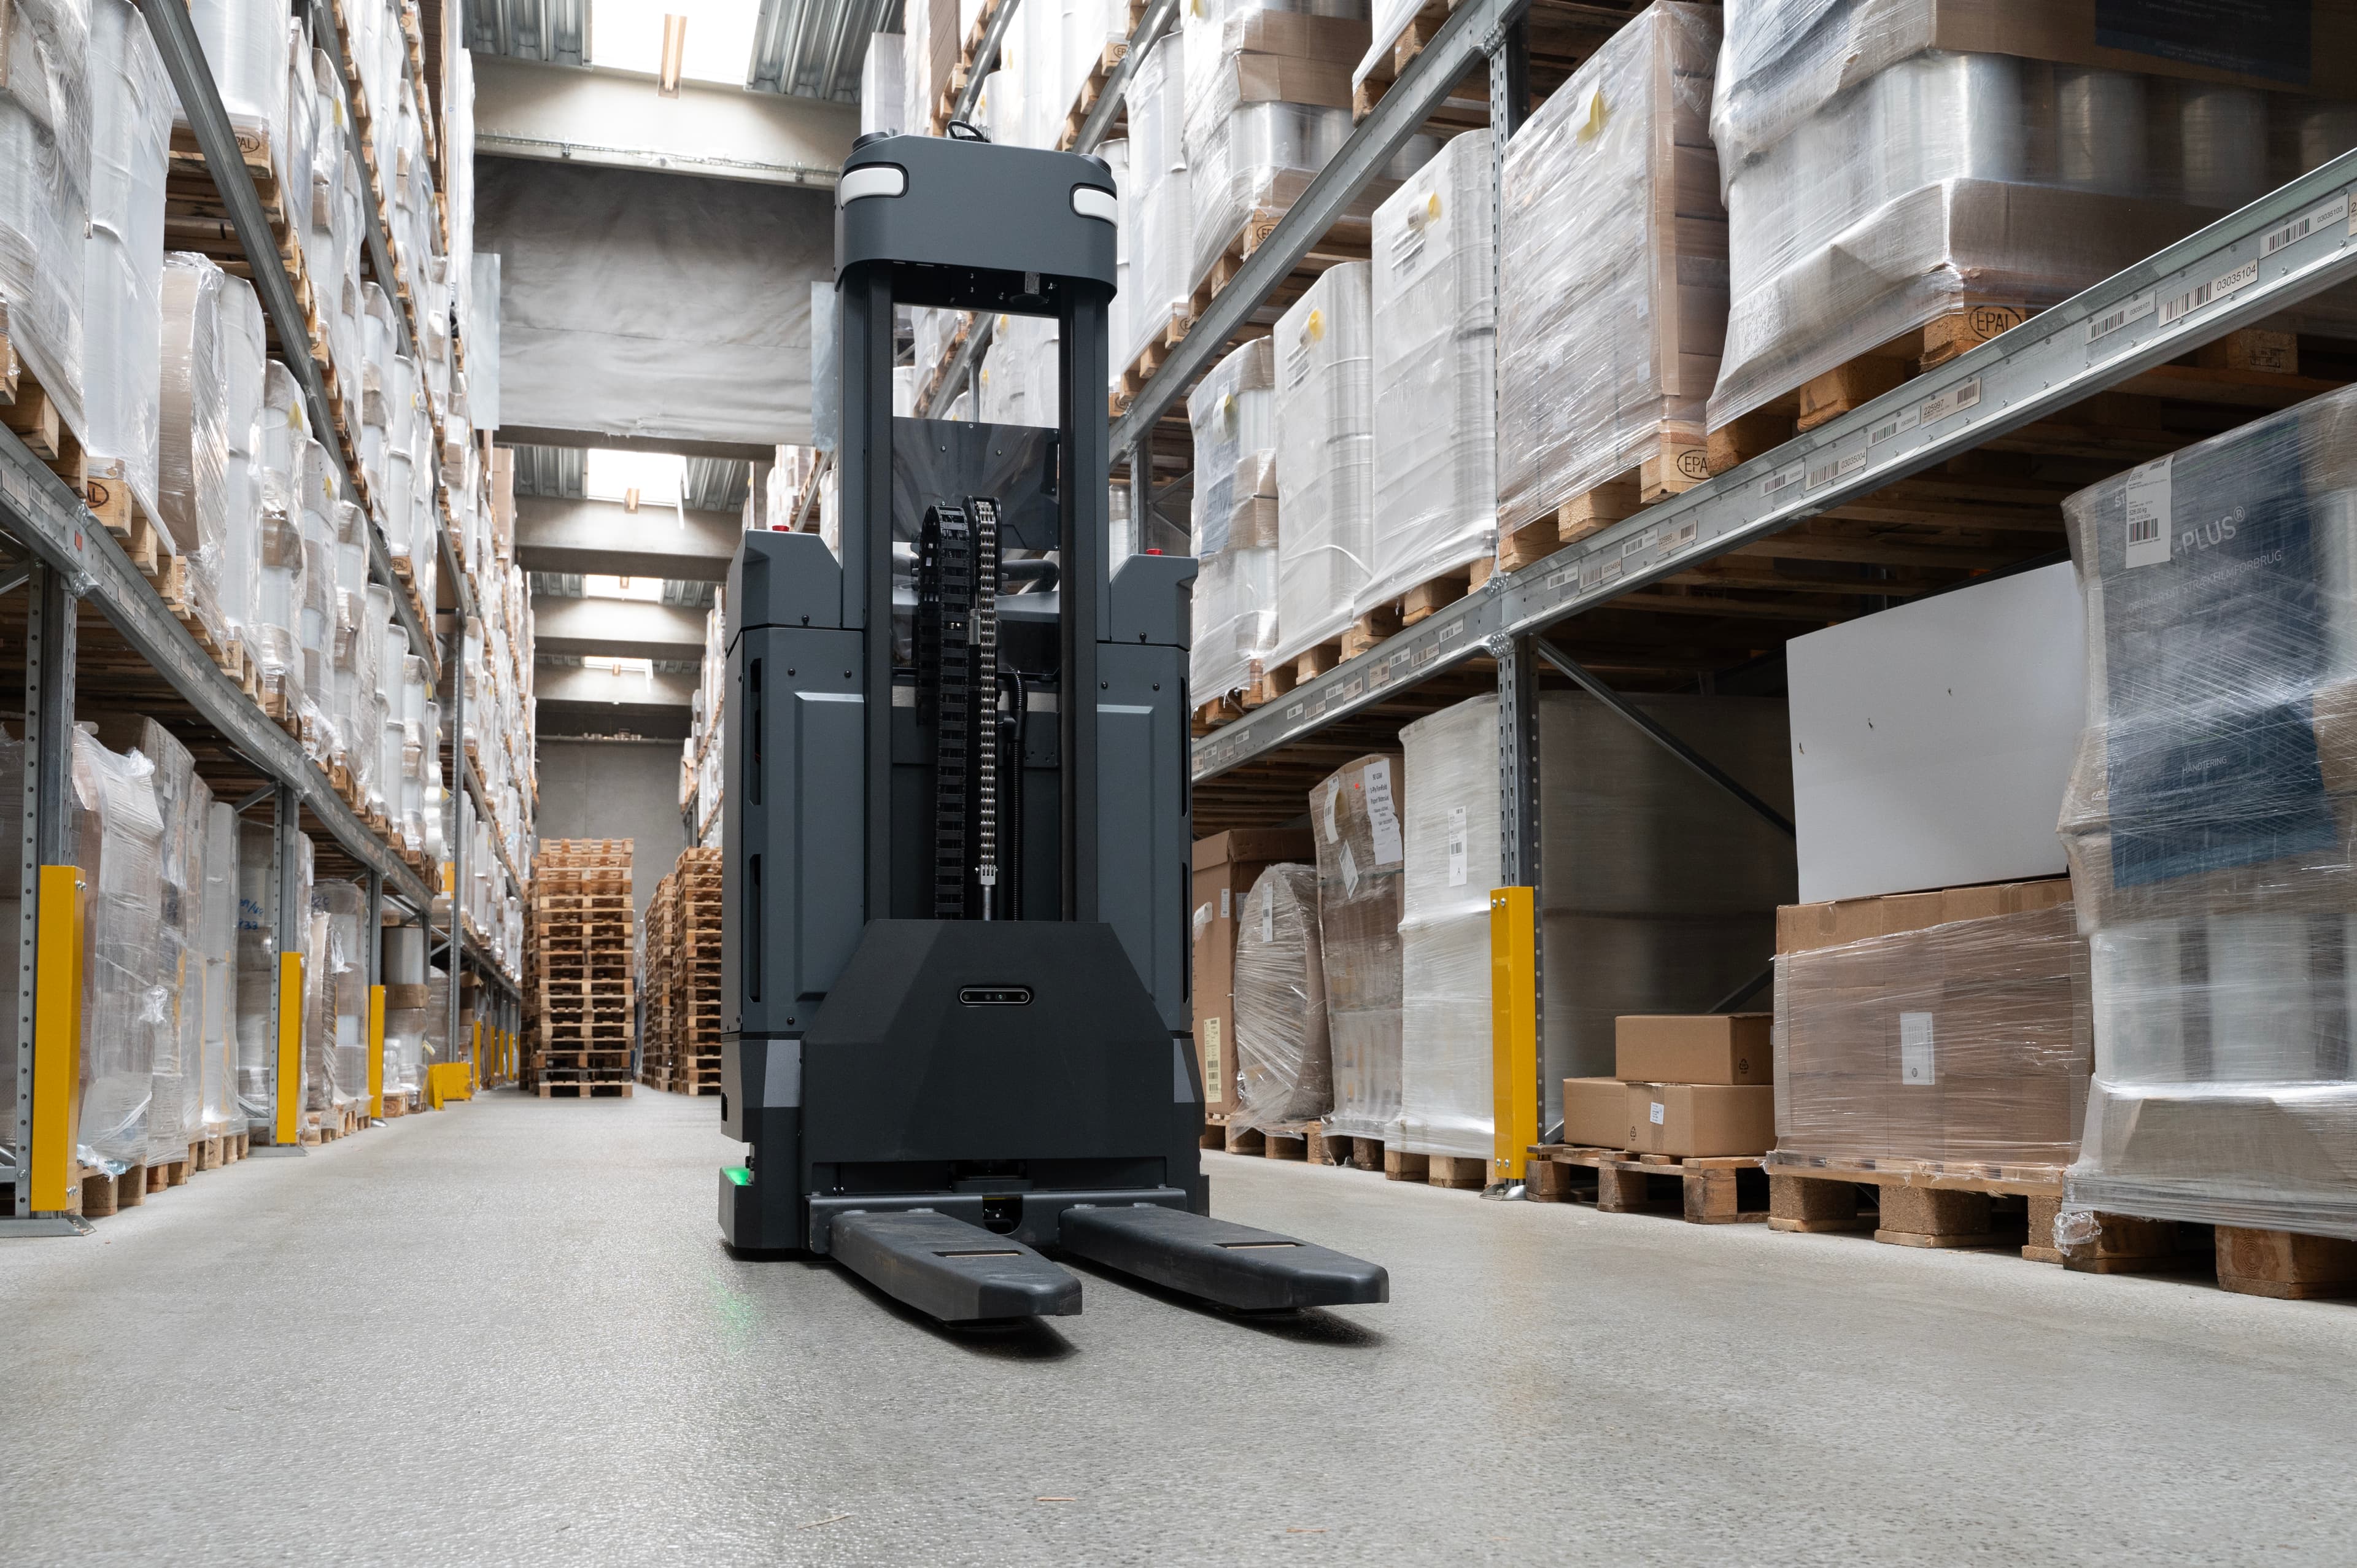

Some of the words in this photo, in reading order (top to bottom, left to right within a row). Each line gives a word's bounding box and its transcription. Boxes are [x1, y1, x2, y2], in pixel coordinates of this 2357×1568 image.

[2316, 205, 2343, 223] 03035103
[2216, 264, 2256, 292] 03035104
[2129, 301, 2151, 316] 03035101
[1924, 398, 1945, 416] 225997
[1841, 451, 1866, 469] 03035004
